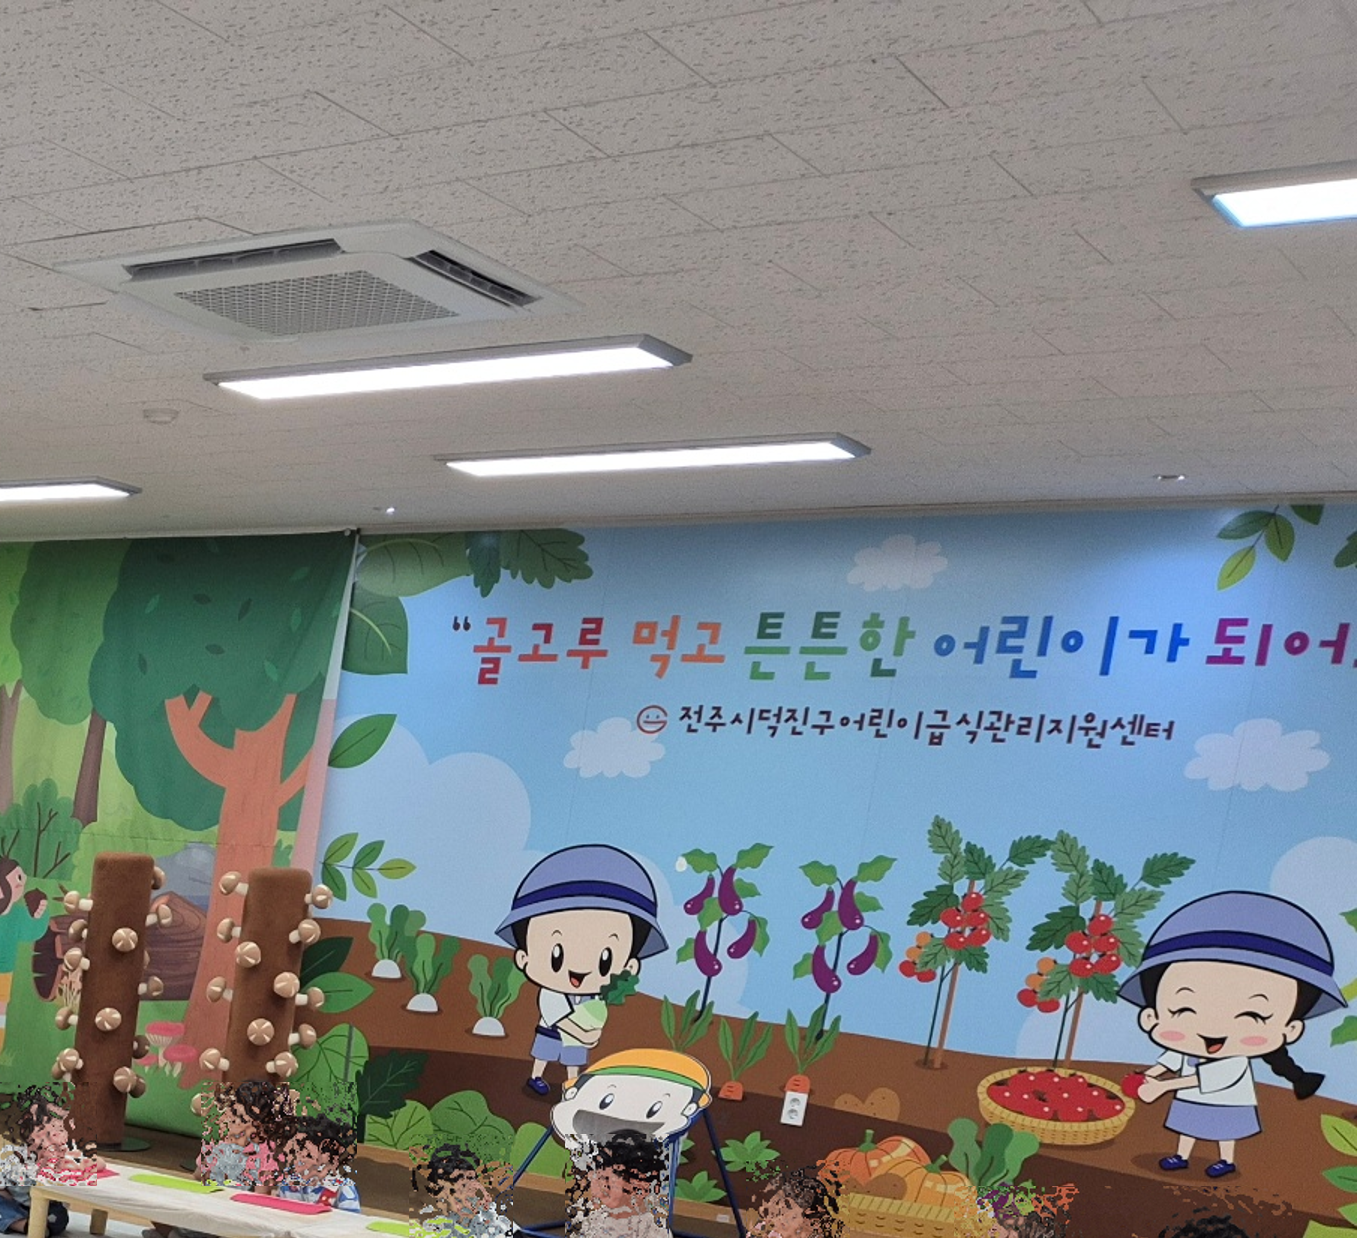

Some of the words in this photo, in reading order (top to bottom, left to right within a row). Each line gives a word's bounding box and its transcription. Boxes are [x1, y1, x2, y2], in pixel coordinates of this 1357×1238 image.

[632, 614, 726, 679] 먹고
[744, 611, 916, 681] 튼튼한
[933, 615, 1191, 679] 어린이가
[1205, 617, 1357, 669] 되어
